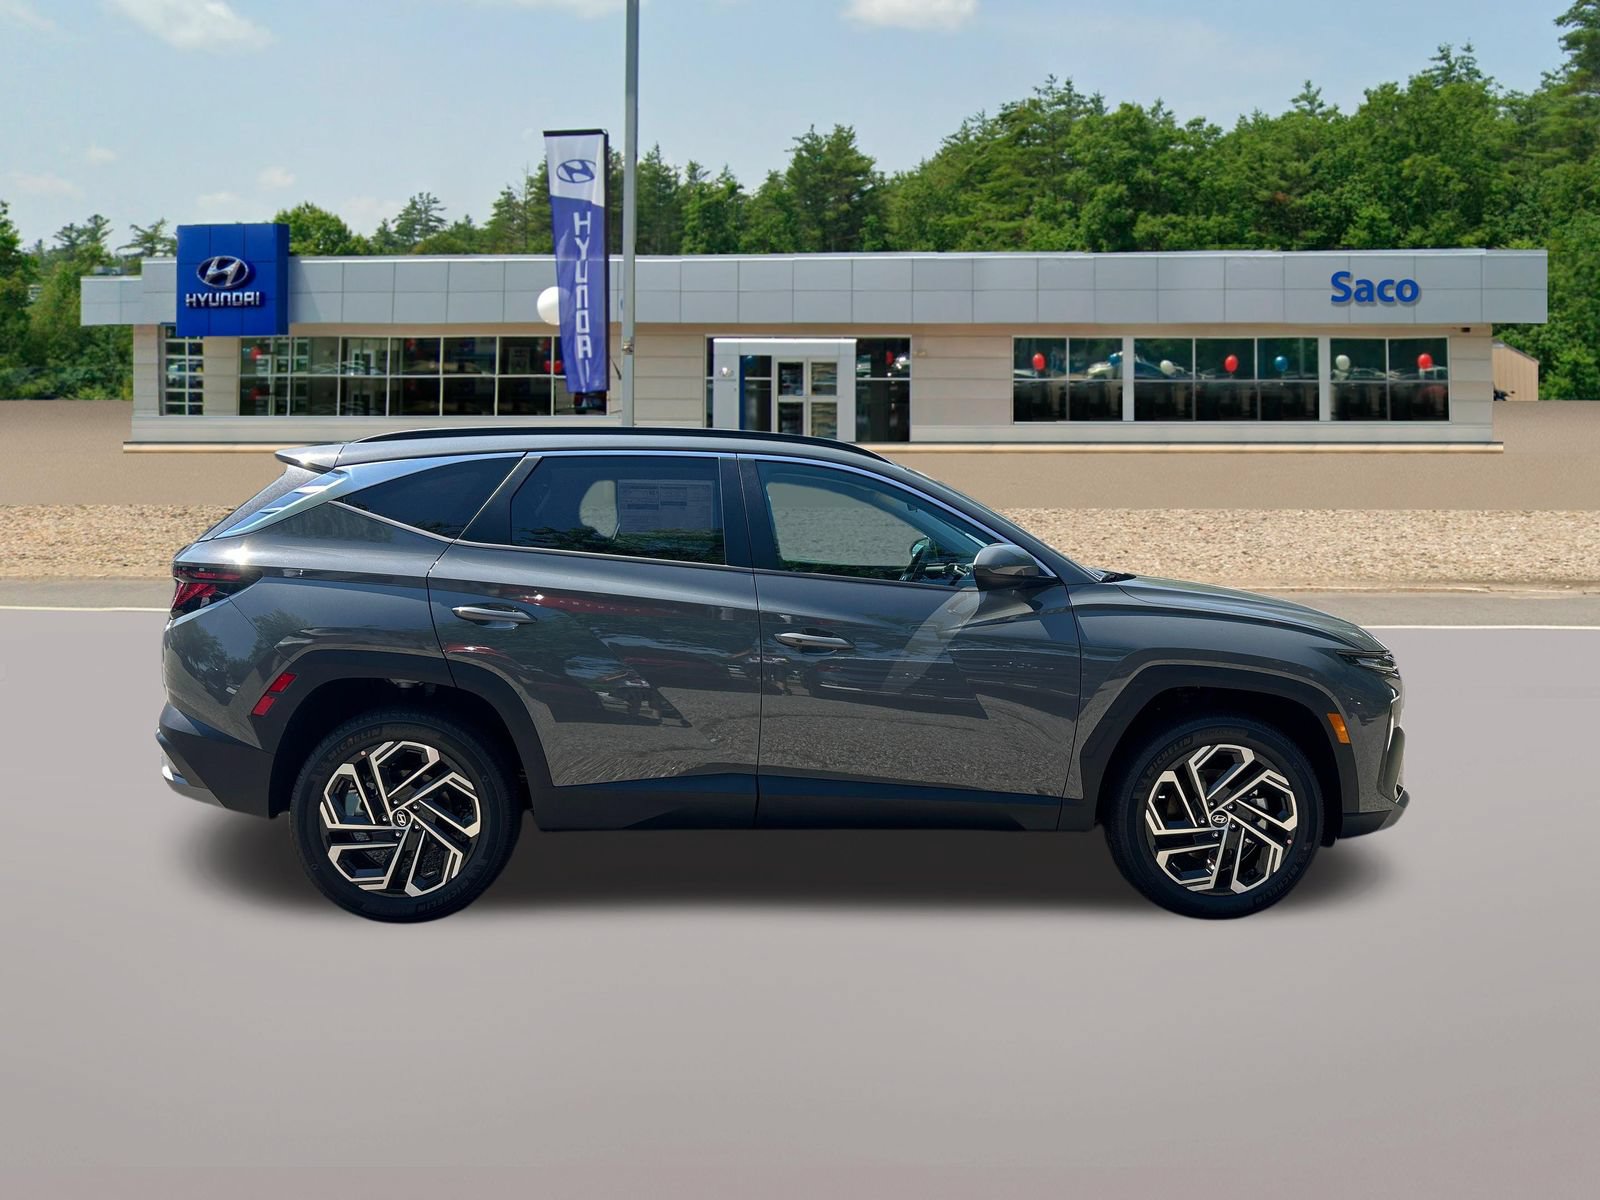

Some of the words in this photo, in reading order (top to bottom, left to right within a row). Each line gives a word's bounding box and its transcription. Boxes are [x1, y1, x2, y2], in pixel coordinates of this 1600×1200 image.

[185, 291, 260, 307] HYUNDAI
[573, 211, 592, 383] HYUNDAI
[1331, 271, 1419, 302] Saco
